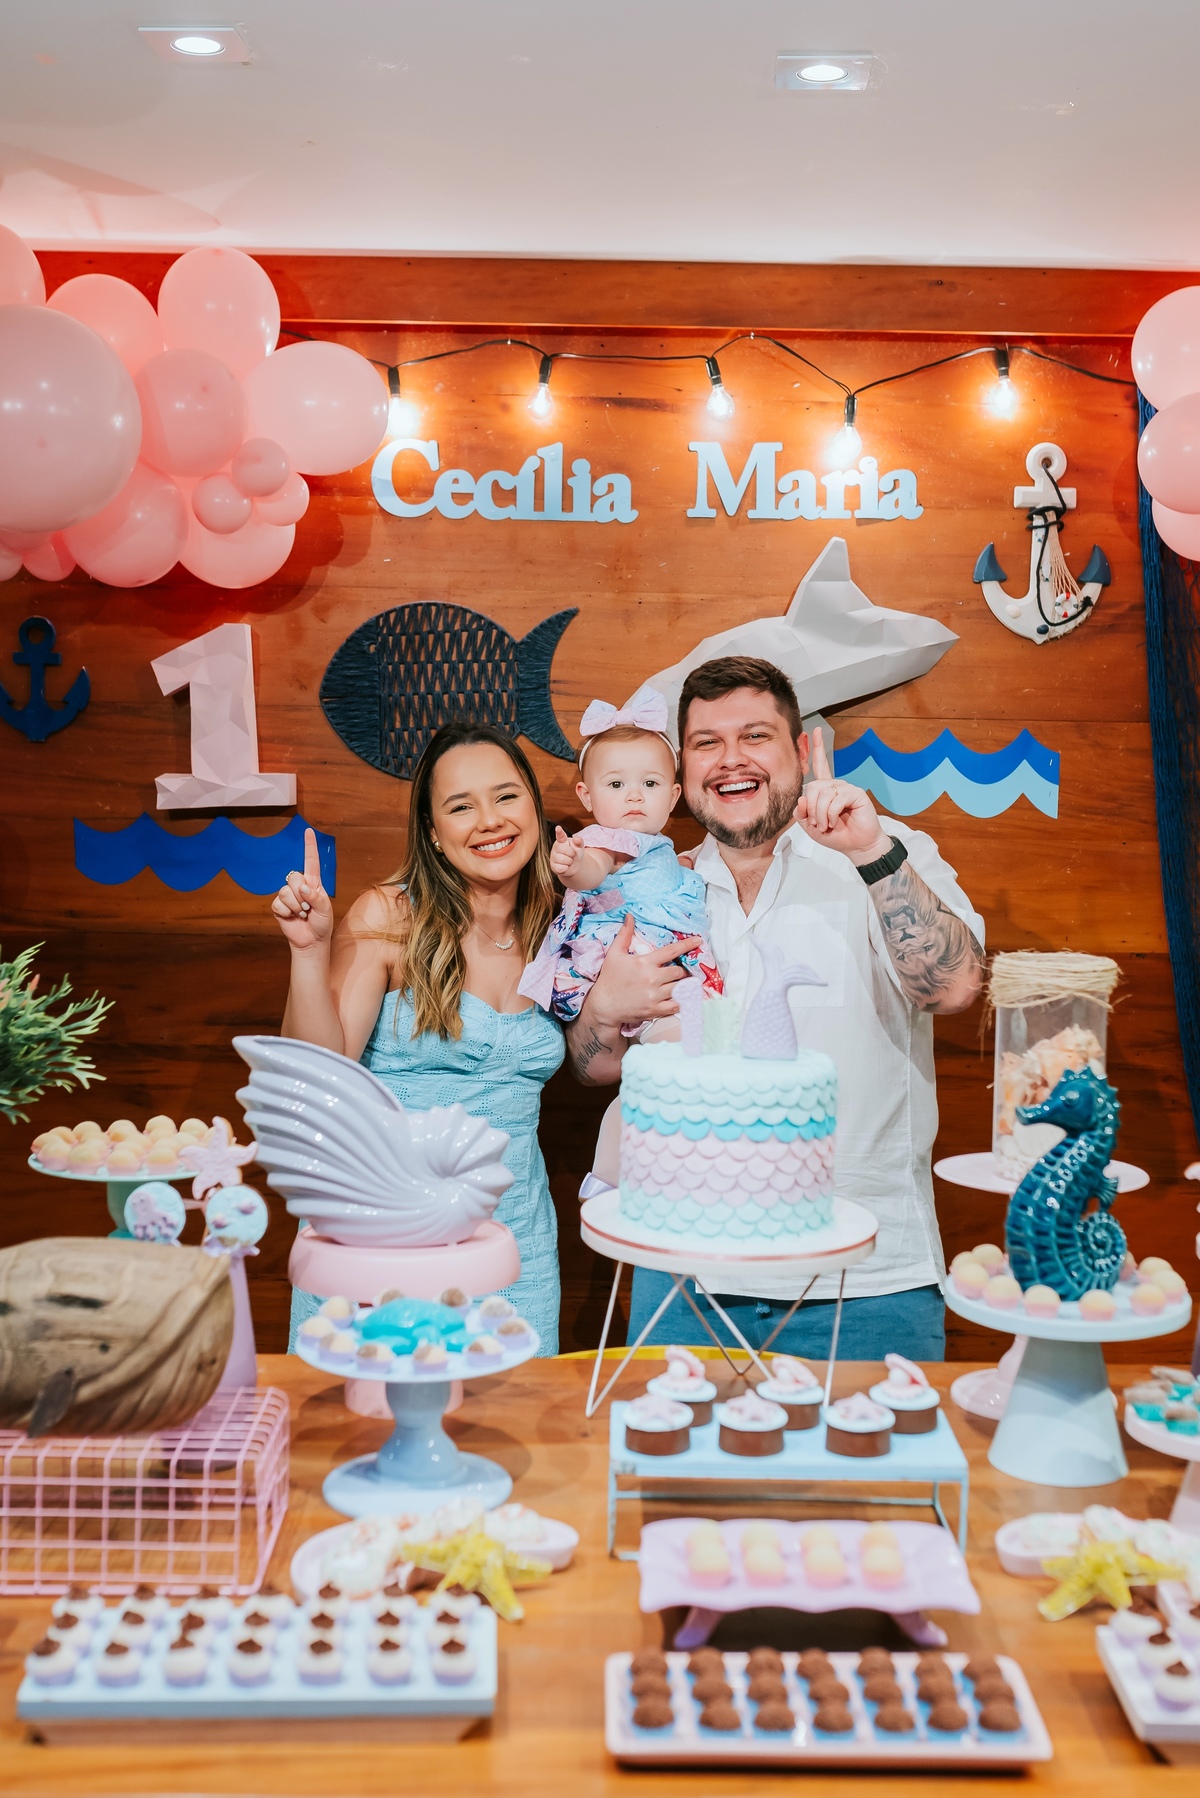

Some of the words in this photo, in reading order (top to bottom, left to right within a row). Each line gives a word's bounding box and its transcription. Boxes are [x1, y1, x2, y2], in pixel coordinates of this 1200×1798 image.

[371, 438, 639, 523] Cecília
[686, 442, 924, 520] Maria
[150, 623, 297, 810] 1
